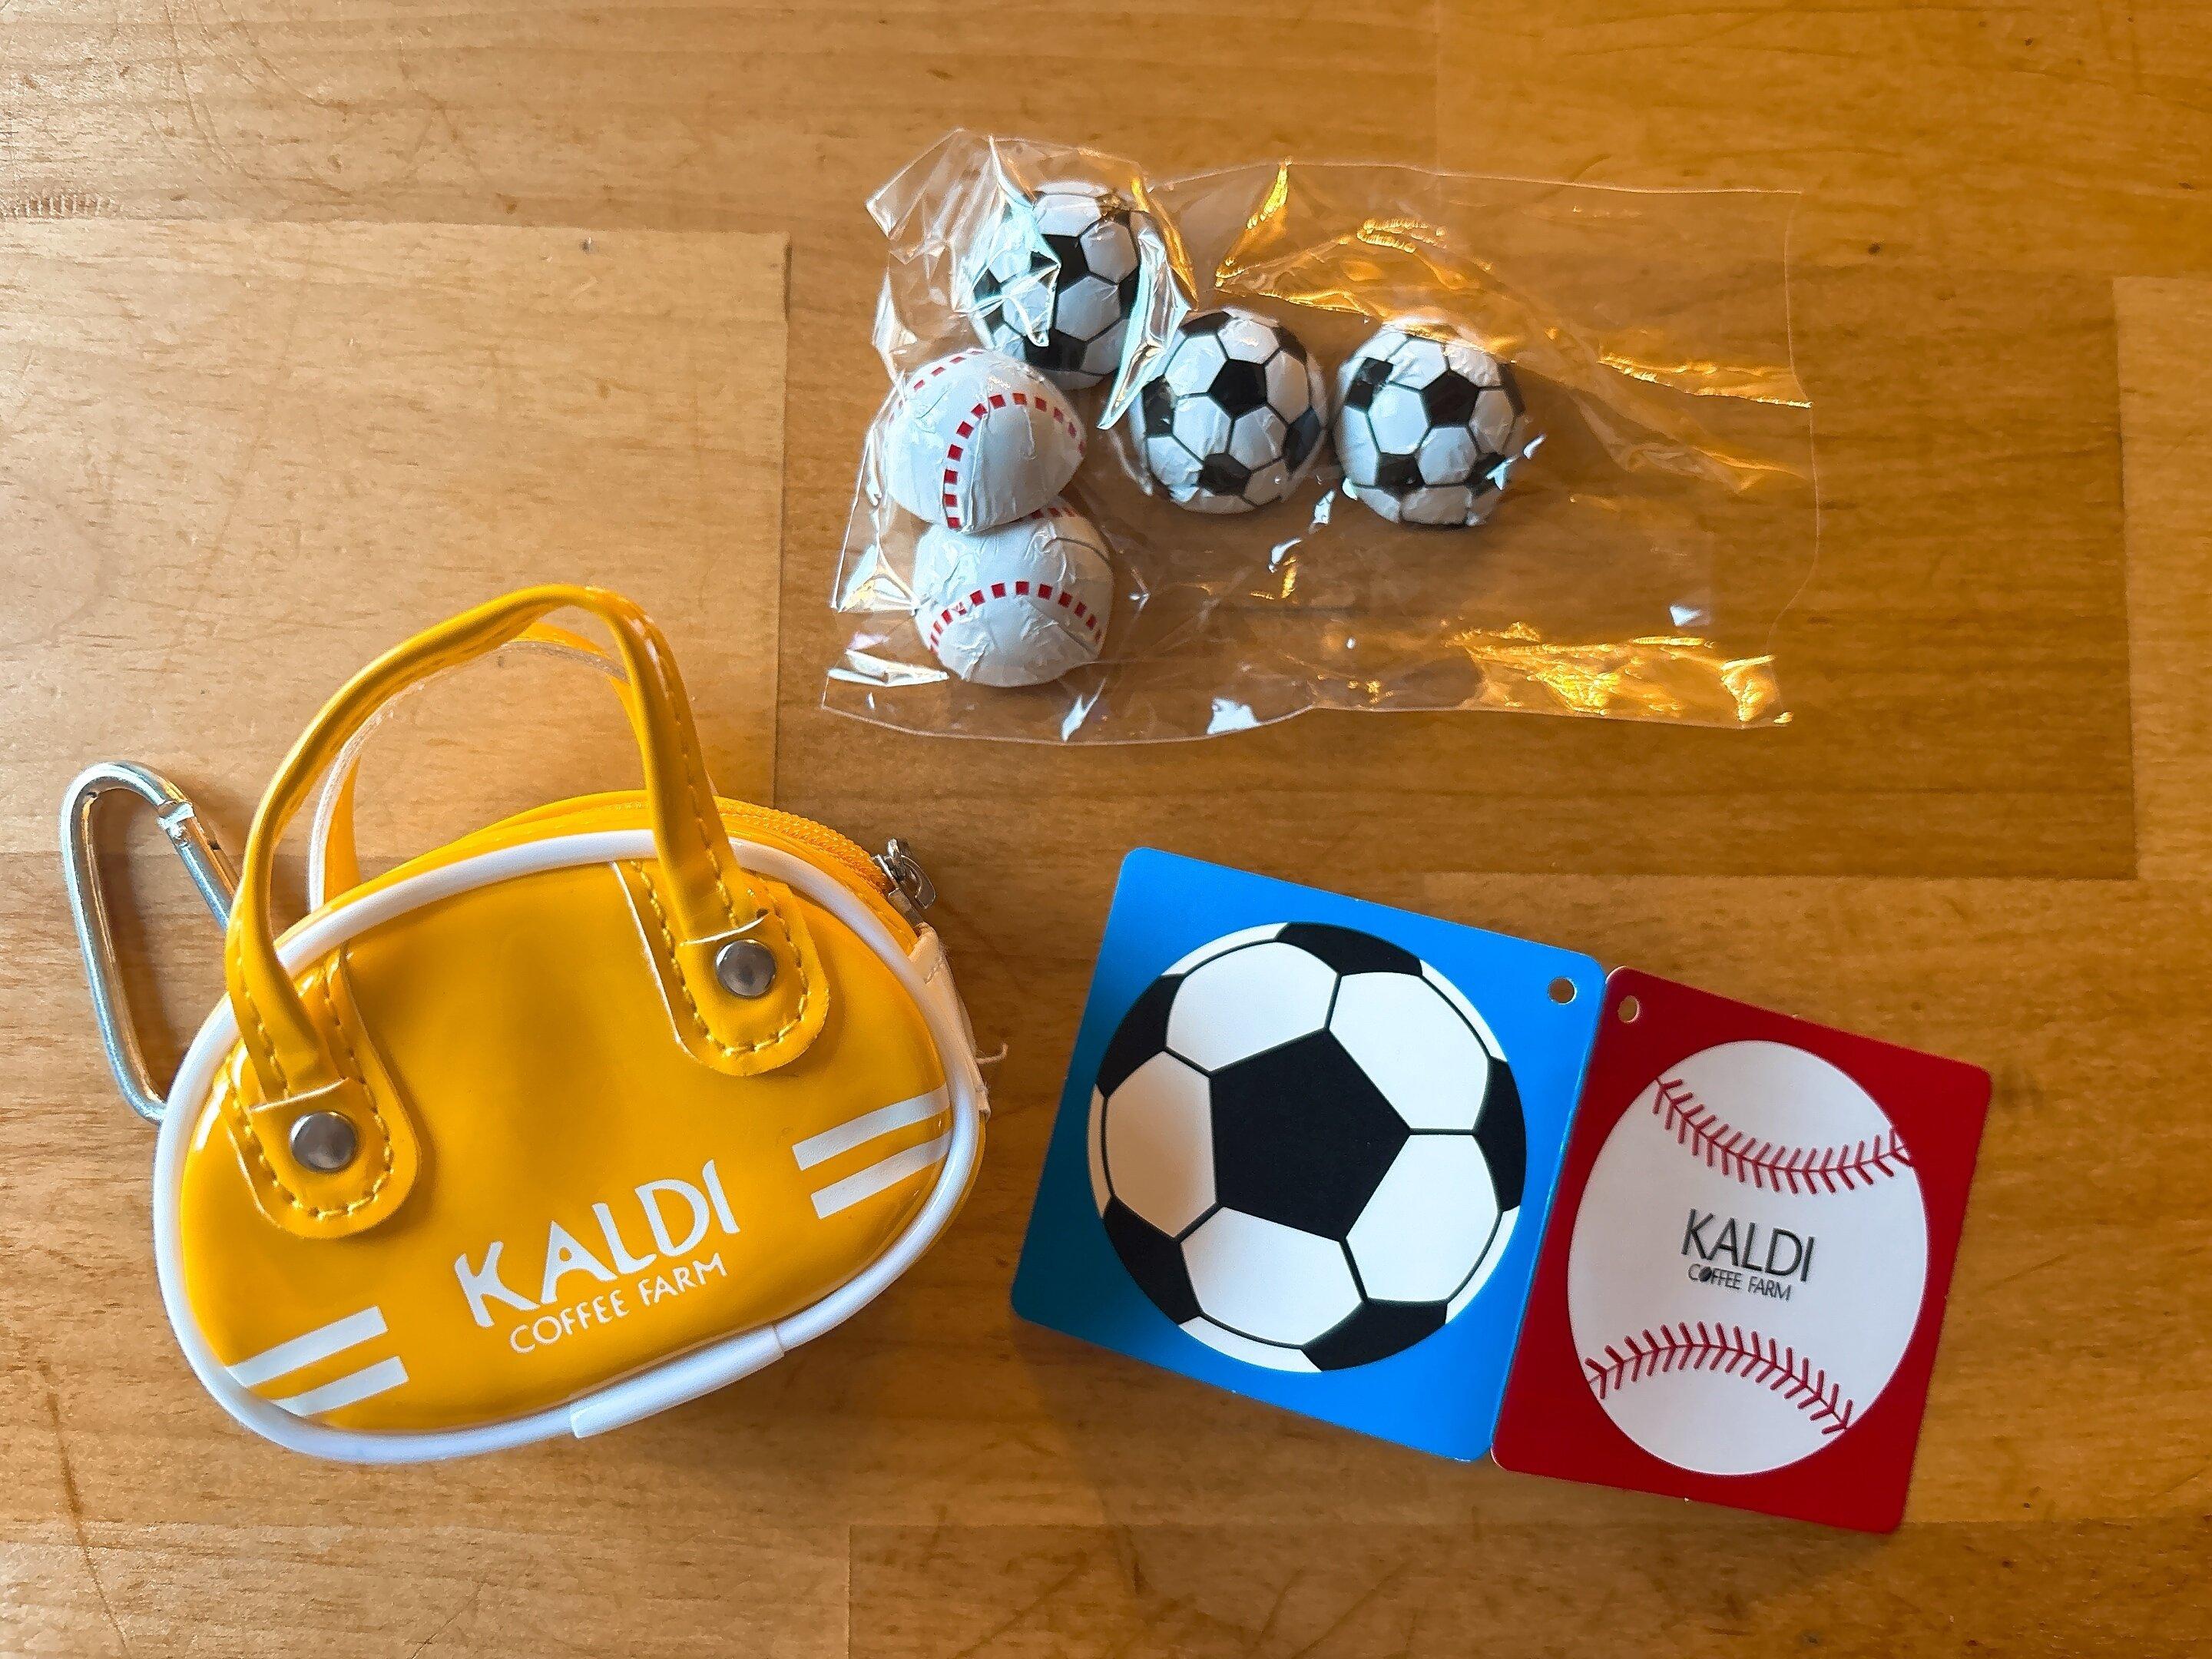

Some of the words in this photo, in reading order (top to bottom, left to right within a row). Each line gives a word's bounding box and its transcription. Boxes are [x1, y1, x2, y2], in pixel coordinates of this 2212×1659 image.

[453, 1159, 740, 1328] KALDI
[1681, 1208, 1815, 1282] KALDI
[1687, 1263, 1742, 1290] COFFEE
[1747, 1276, 1793, 1301] FARM
[509, 1290, 631, 1353] COFFEE
[637, 1253, 727, 1306] FARM
